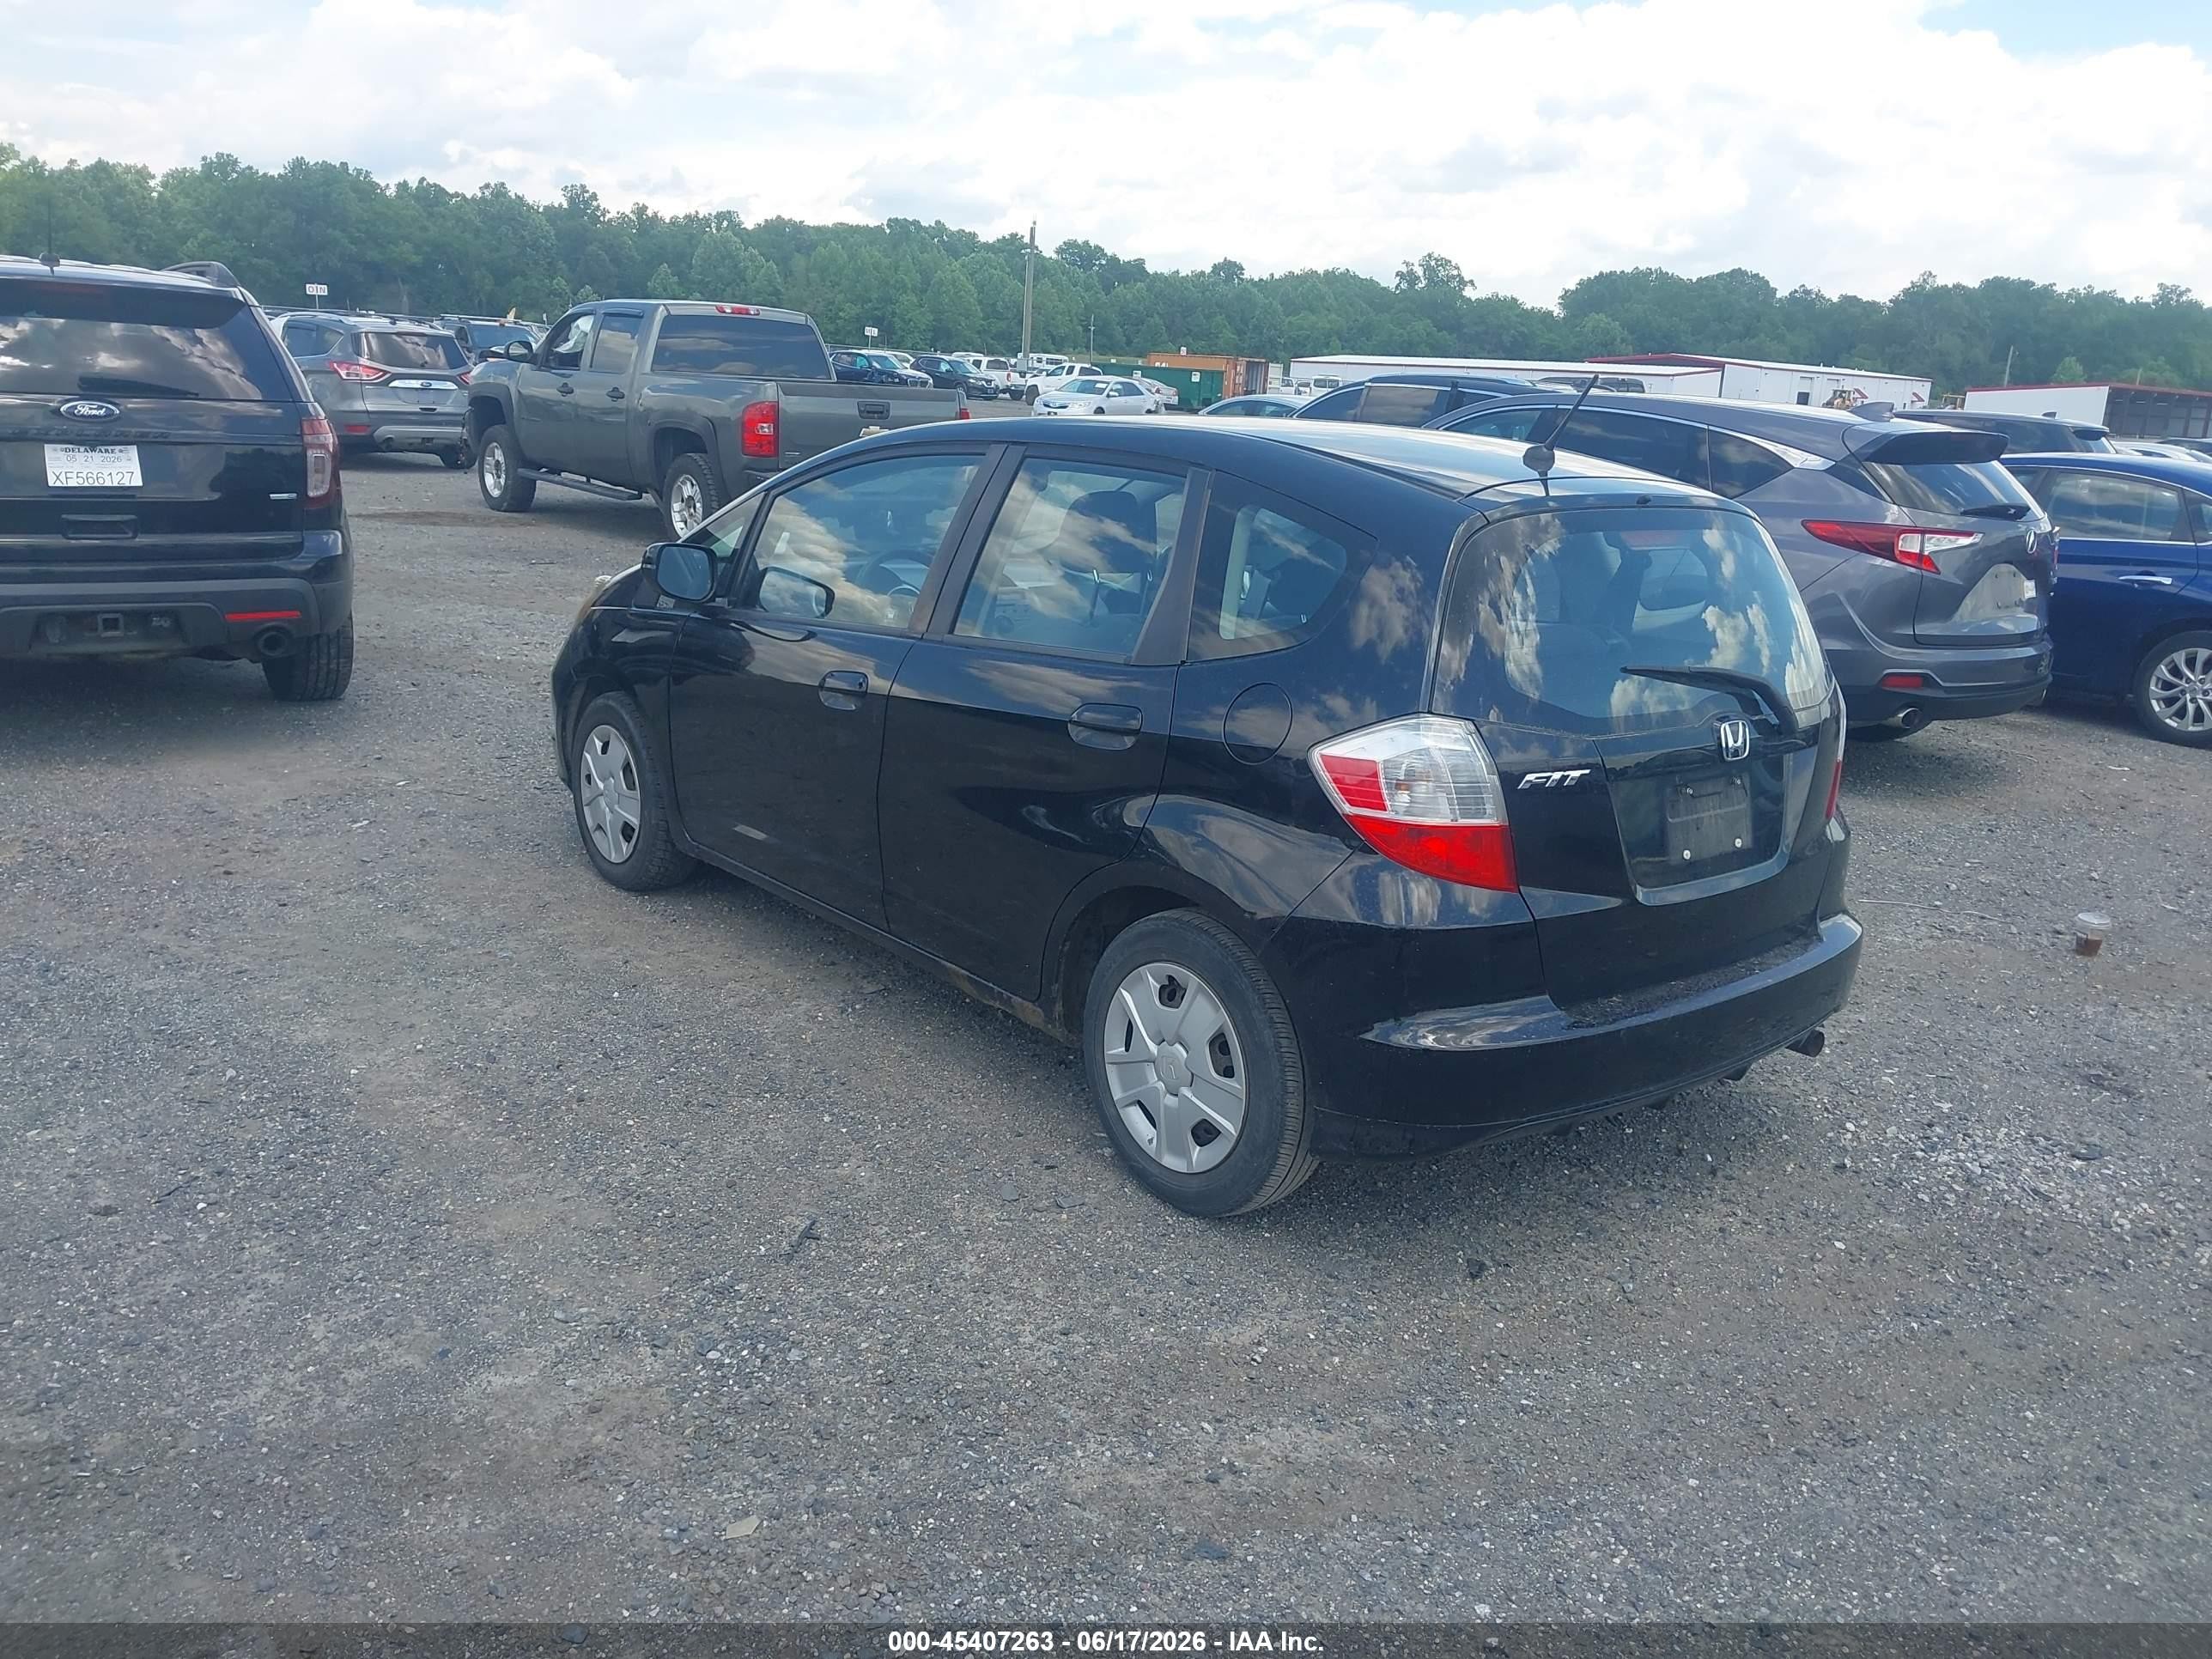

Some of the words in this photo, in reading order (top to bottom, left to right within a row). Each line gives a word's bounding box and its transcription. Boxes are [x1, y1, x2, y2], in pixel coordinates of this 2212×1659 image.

[74, 404, 106, 416] Ford
[66, 454, 77, 463] 05
[100, 455, 123, 464] 2026
[52, 471, 135, 485] XF566127
[1517, 769, 1592, 789] FIT
